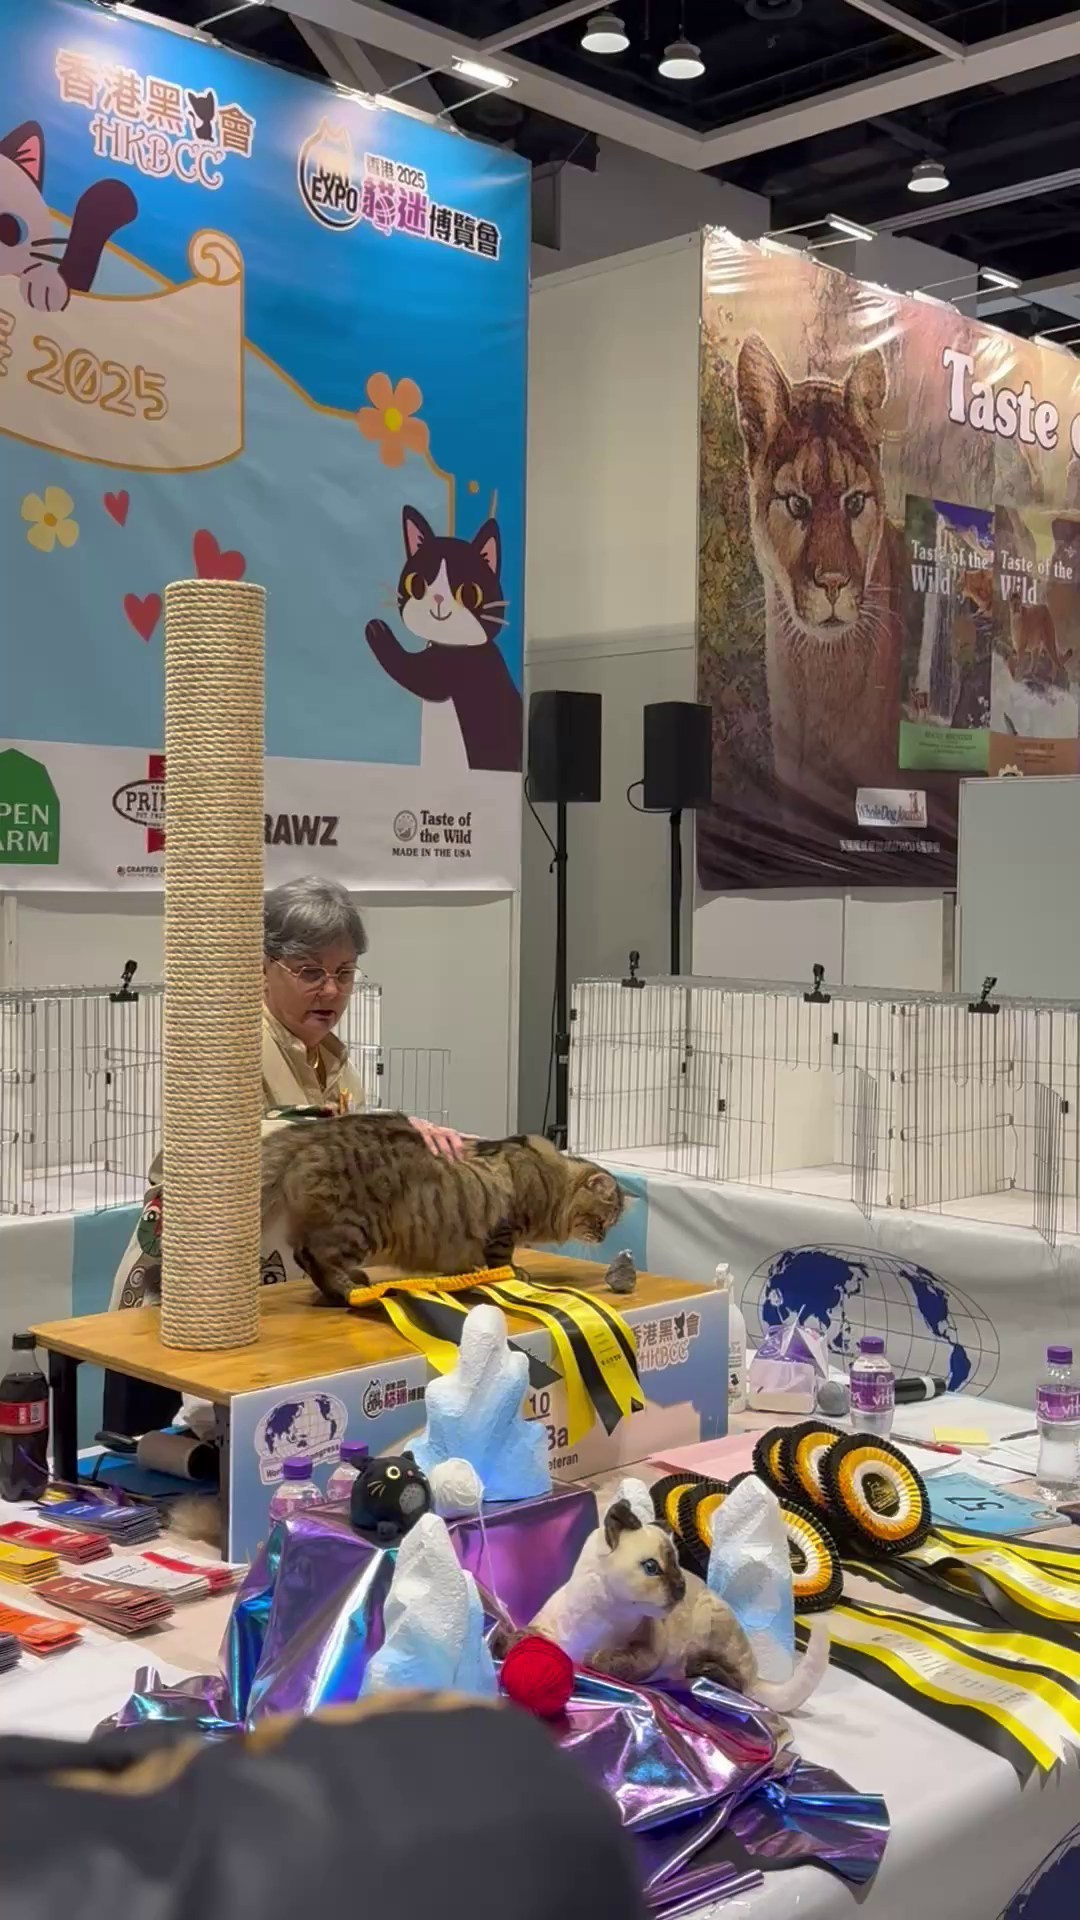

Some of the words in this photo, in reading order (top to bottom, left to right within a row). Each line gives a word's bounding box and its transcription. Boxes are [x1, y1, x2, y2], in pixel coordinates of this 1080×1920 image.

[92, 119, 223, 187] HKBCC
[397, 165, 425, 189] 2025
[312, 176, 358, 214] EXPO
[26, 335, 169, 421] 2025
[942, 346, 1059, 450] Taste
[911, 539, 945, 564] Taste
[951, 549, 964, 567] of
[968, 550, 989, 570] the
[1001, 550, 1033, 573] Taste
[1038, 558, 1050, 574] of
[1054, 561, 1073, 580] the
[911, 564, 950, 595] Wild
[1000, 574, 1038, 605] Wild
[421, 810, 454, 827] Taste
[458, 812, 472, 827] of
[420, 829, 440, 844] the
[443, 829, 472, 844] Wild
[392, 847, 419, 857] MADE
[421, 847, 431, 857] IN
[435, 848, 451, 858] THE
[454, 848, 471, 858] USA
[529, 1391, 551, 1415] 10
[548, 1453, 578, 1470] eteran
